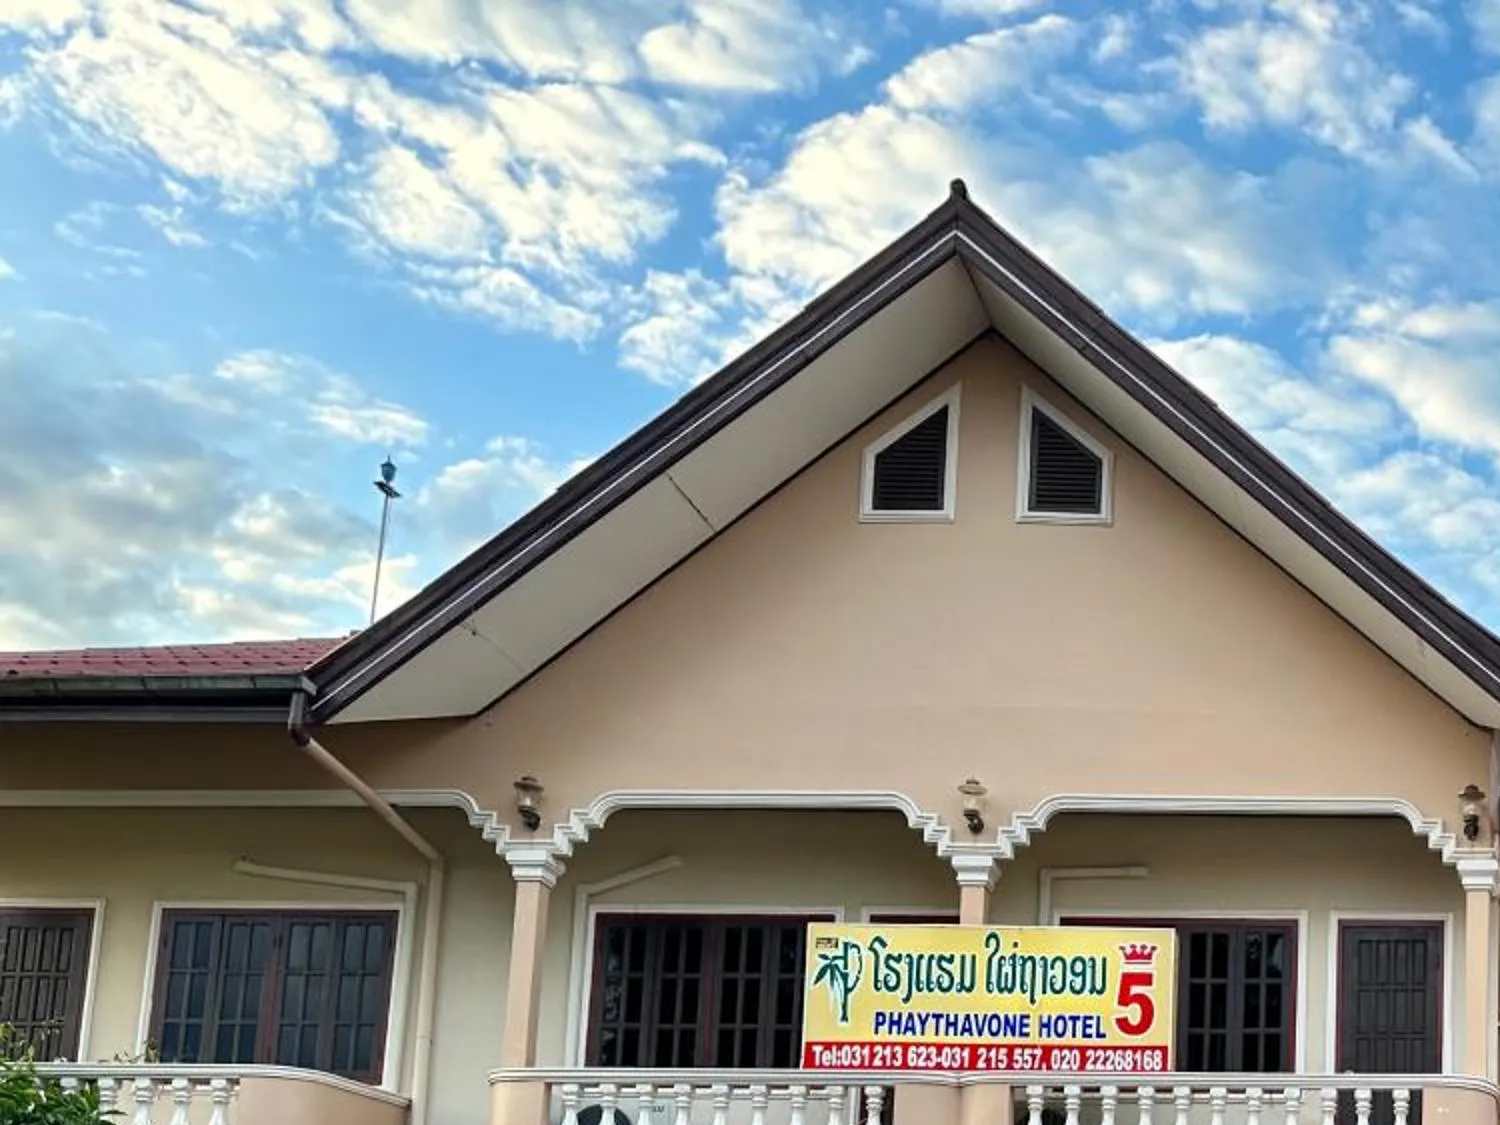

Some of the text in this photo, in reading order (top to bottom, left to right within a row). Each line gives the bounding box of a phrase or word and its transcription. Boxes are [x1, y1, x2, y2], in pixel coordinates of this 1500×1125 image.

[868, 935, 977, 1004] ໂຮງແຮມ
[873, 1011, 1107, 1039] PHAYTHAVONE HOTEL
[1115, 971, 1156, 1036] 5
[872, 1046, 902, 1068] 213
[907, 1047, 970, 1069] 623-031
[976, 1048, 1008, 1070] 215
[1051, 1049, 1080, 1071] 020
[1086, 1049, 1163, 1072] 22268168
